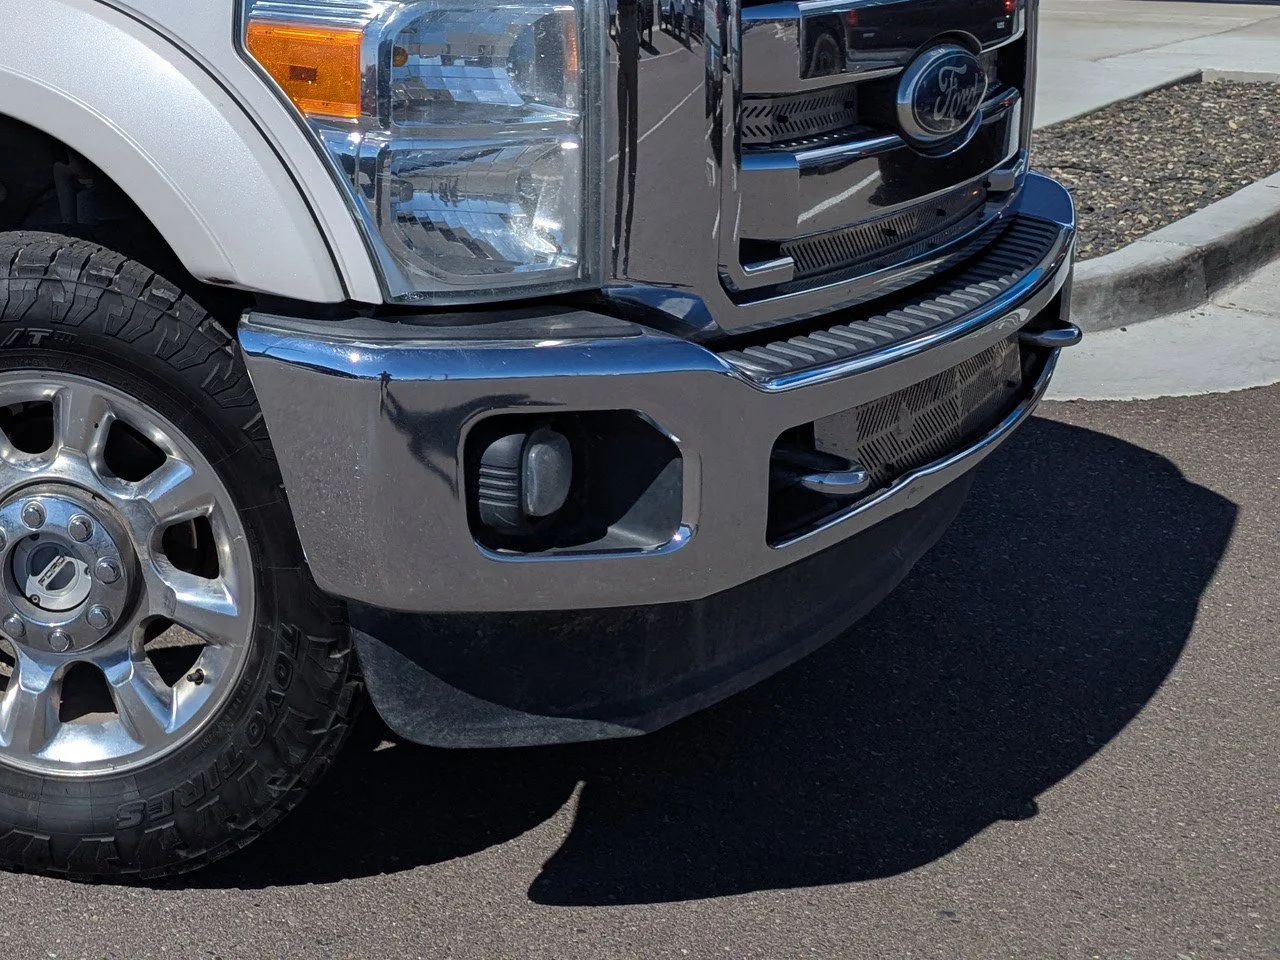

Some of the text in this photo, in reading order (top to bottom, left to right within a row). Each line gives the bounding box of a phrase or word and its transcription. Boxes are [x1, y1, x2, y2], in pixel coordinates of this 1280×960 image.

[933, 63, 979, 122] Ford
[245, 623, 301, 748] TOYO
[116, 743, 246, 830] TIRES
